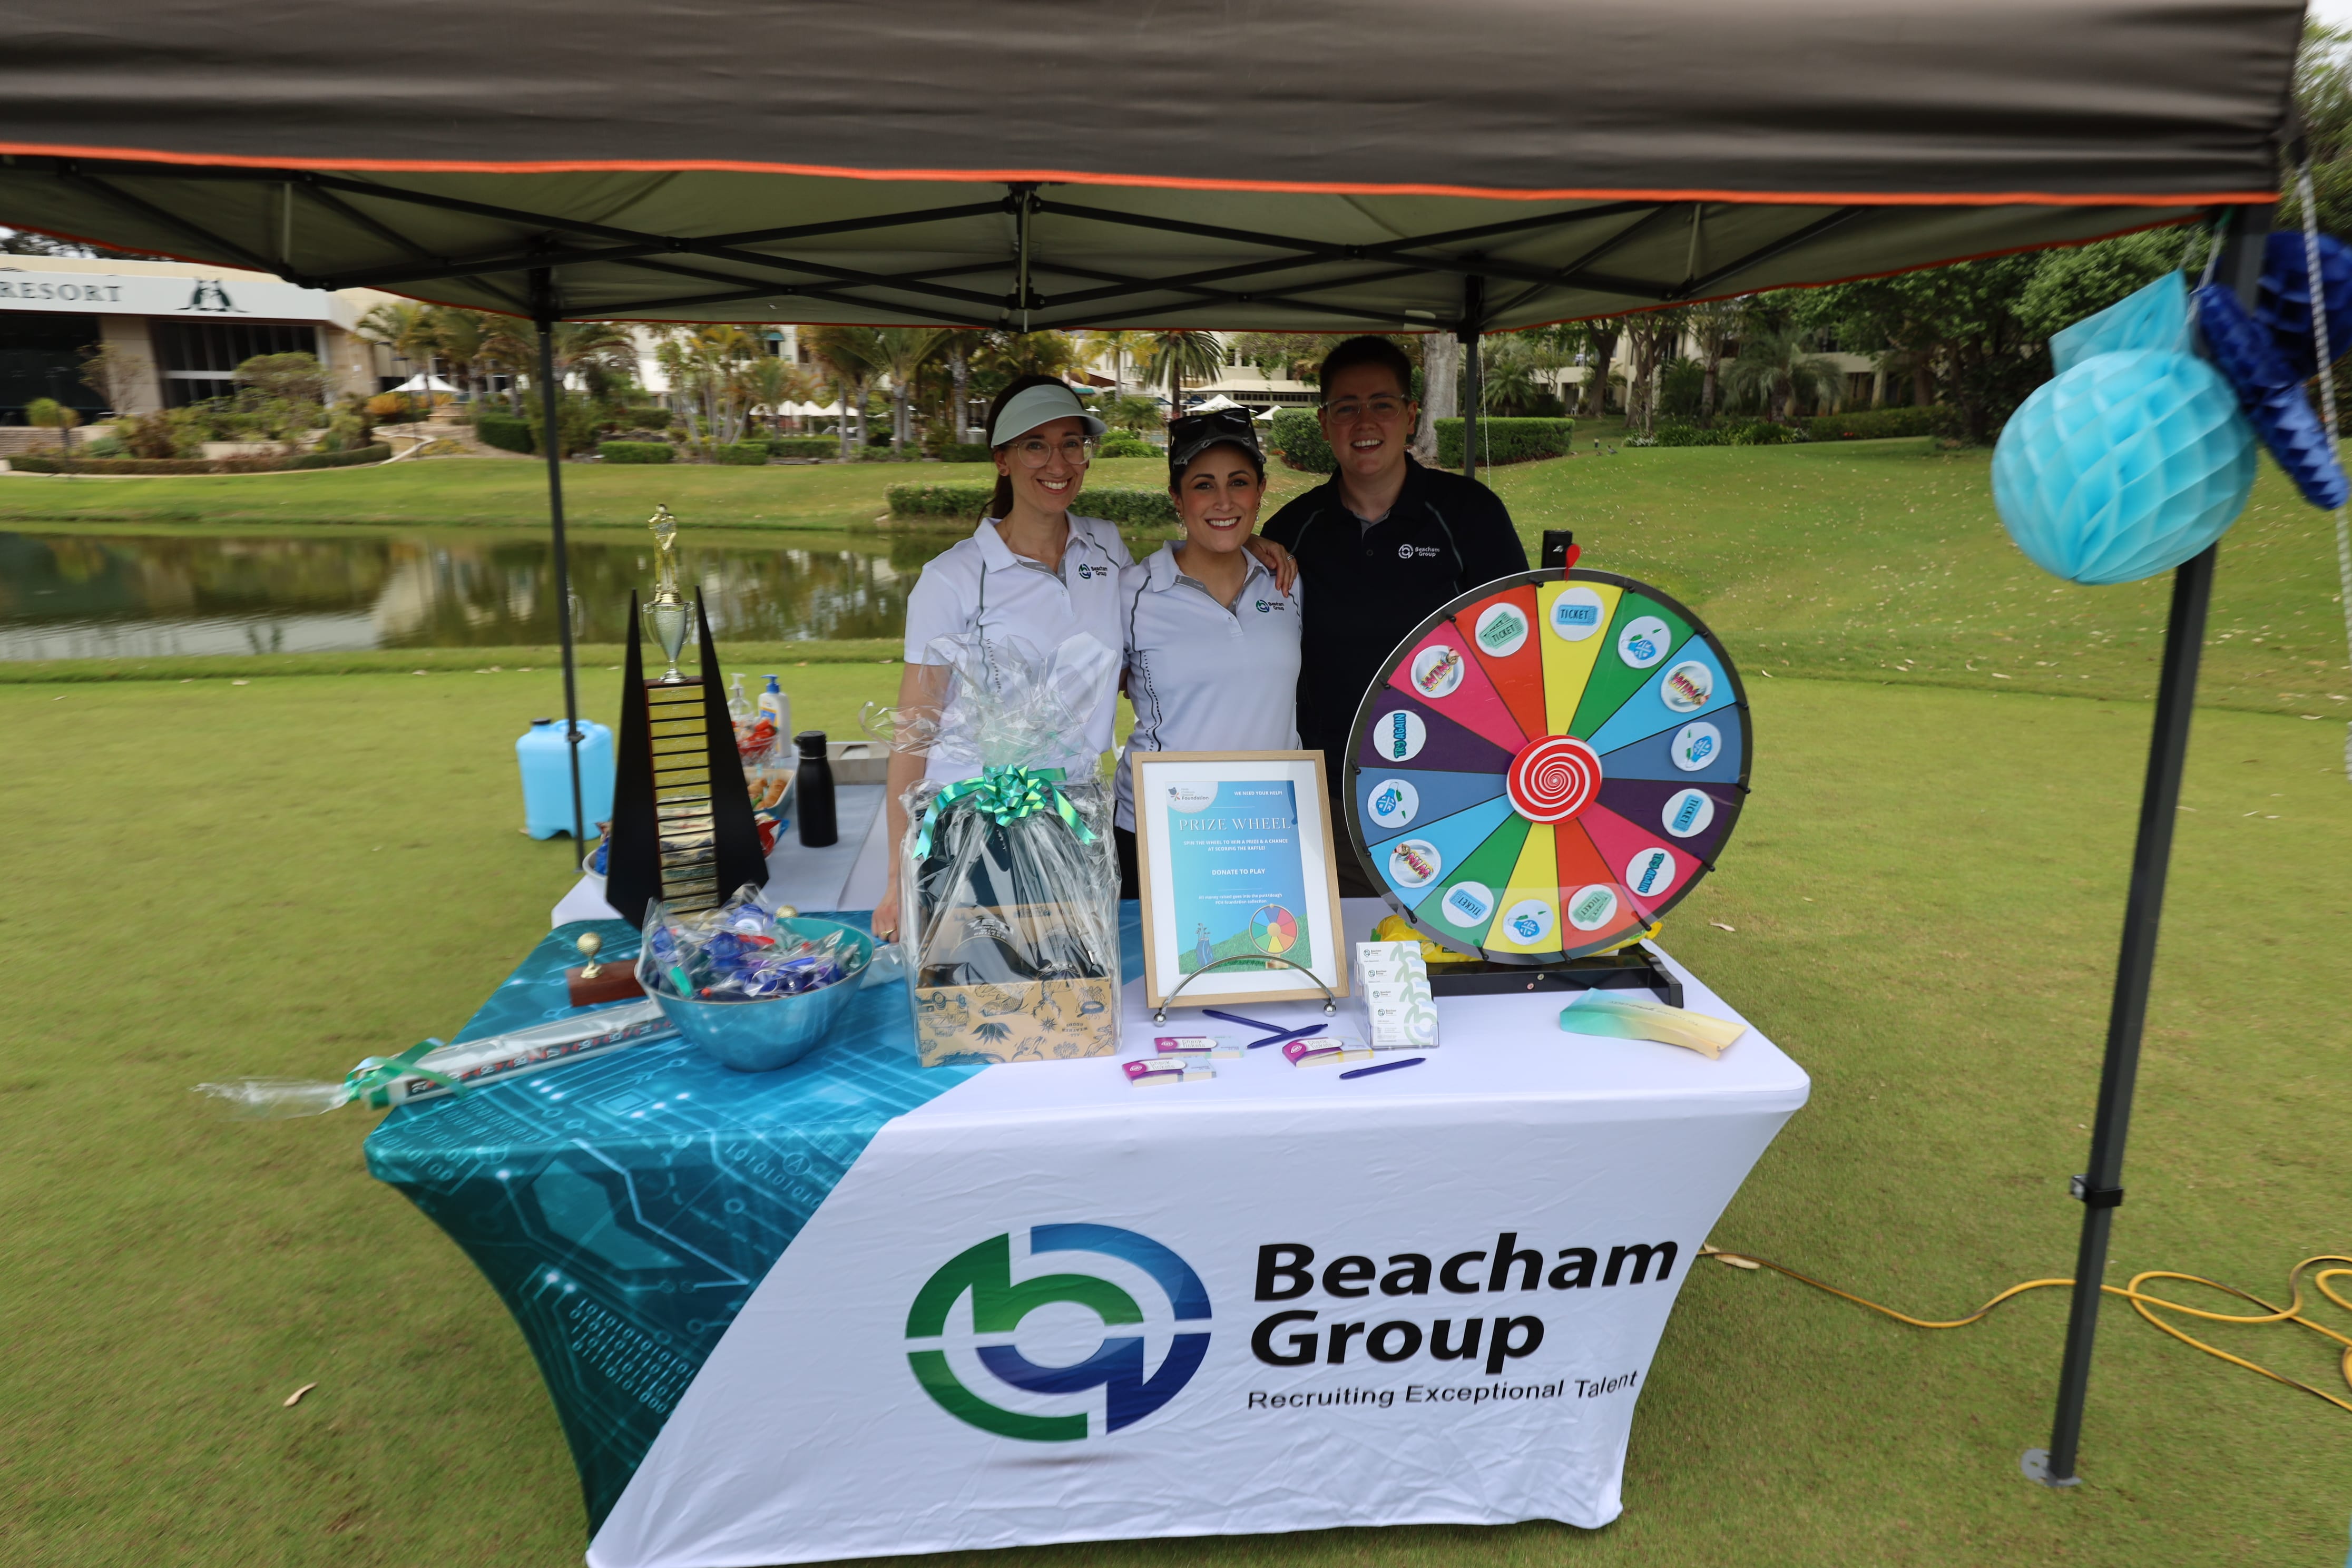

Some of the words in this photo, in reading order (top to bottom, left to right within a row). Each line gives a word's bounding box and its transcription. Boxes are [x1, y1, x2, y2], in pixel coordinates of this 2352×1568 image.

[0, 281, 123, 302] RESORT
[1560, 609, 1590, 620] TICKET
[1491, 624, 1515, 642] TICKET
[1420, 660, 1451, 689] WIN
[1672, 673, 1700, 699] WIN
[1394, 713, 1406, 740] AGAIN
[1394, 740, 1407, 758] TRY
[1680, 799, 1699, 824] TICKET
[1179, 819, 1227, 831] PRIZE
[1232, 818, 1291, 830] WHEEL
[1405, 852, 1432, 879] WIN
[1649, 853, 1665, 869] TRY
[1638, 867, 1657, 894] AGAIN
[1457, 897, 1482, 916] TICKET
[1581, 897, 1601, 916] TICKET
[609, 1030, 622, 1043] 15
[1255, 1232, 1678, 1302] Beacham
[1251, 1310, 1544, 1375] Group
[1248, 1387, 1394, 1410] Recruiting
[1405, 1380, 1564, 1406] Exceptional
[1575, 1370, 1638, 1399] Talent
